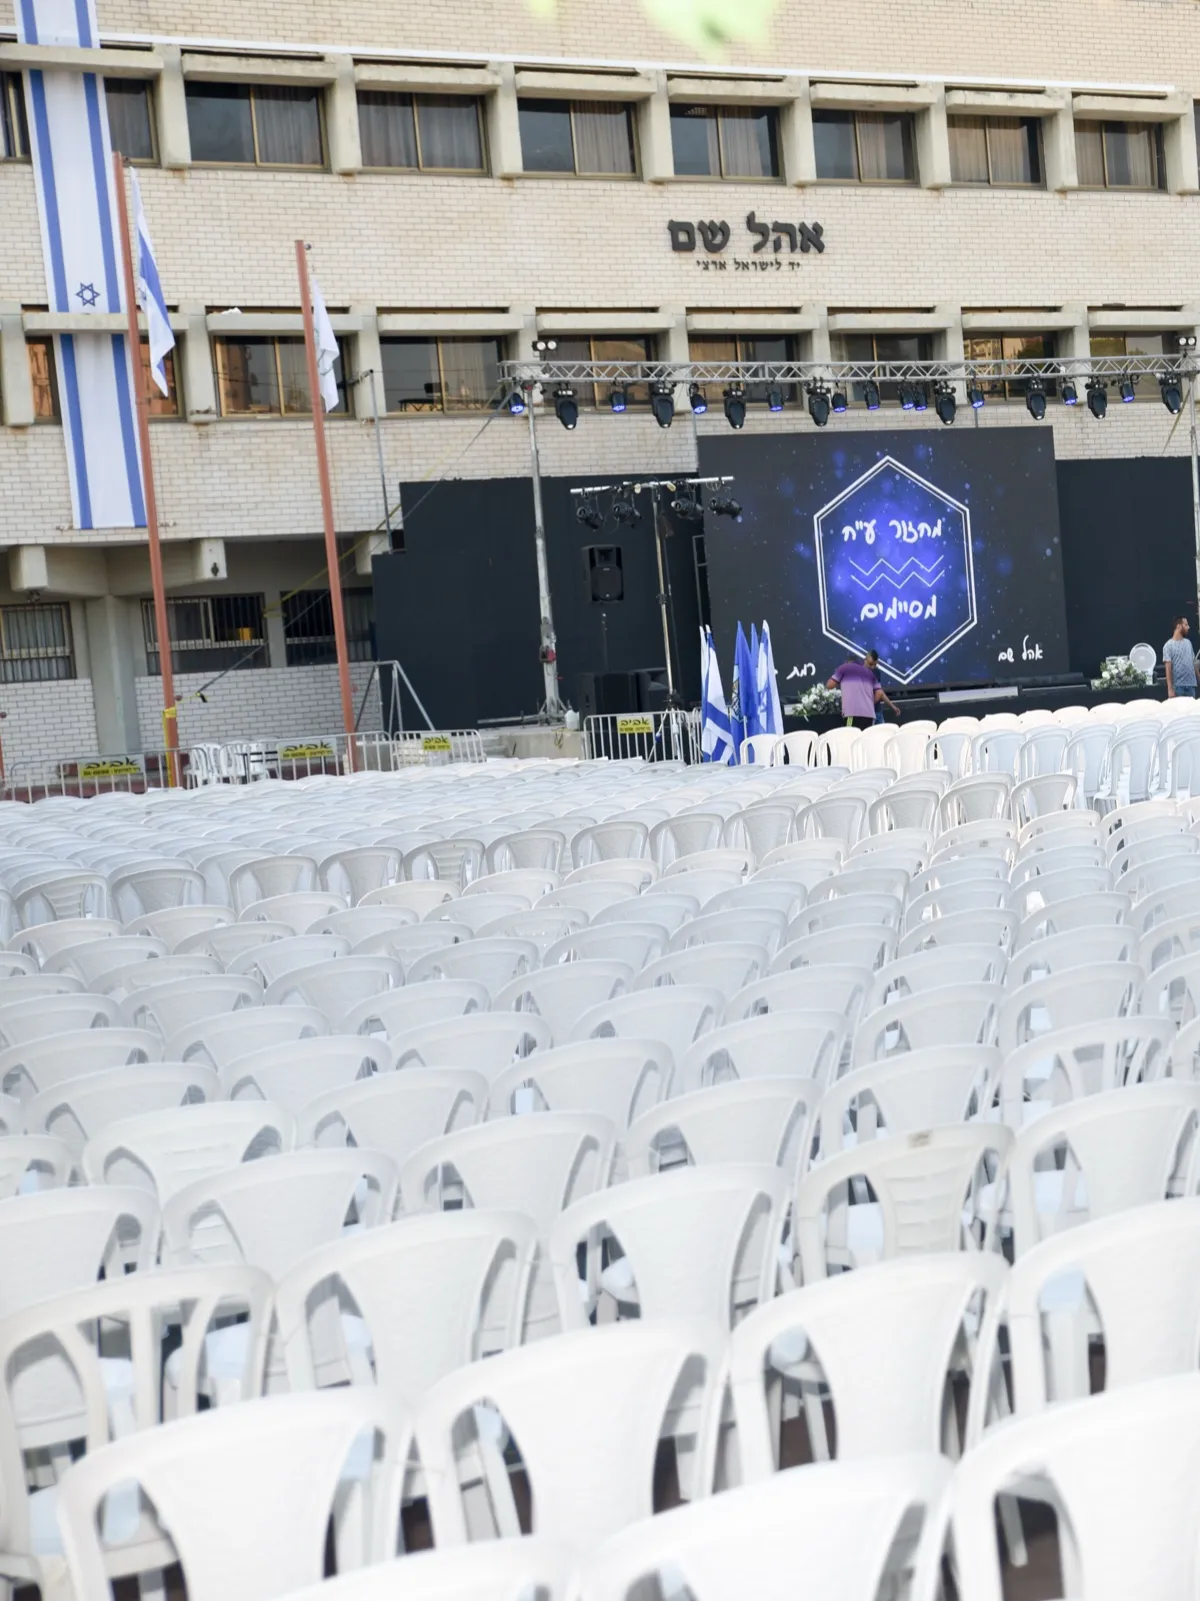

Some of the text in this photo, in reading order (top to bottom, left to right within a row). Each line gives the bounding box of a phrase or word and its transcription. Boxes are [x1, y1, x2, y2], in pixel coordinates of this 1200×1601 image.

[667, 210, 825, 254] אהל שם
[696, 257, 801, 272] יד לישראל ארצי
[888, 518, 942, 544] מחזור
[860, 594, 938, 622] מסיימים
[997, 634, 1044, 662] אהל שם
[785, 661, 816, 680] רמת
